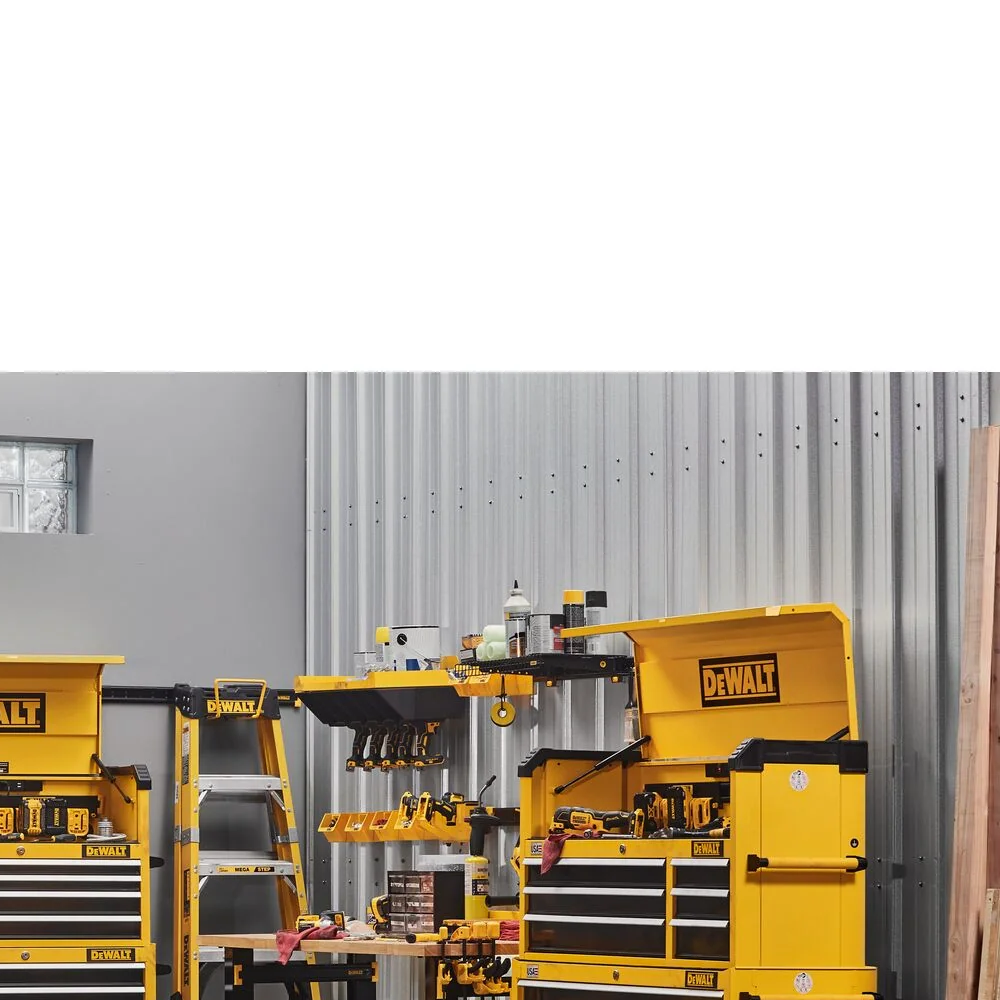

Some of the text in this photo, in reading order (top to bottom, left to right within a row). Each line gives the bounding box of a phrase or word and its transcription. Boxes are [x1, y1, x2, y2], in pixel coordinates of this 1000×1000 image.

[703, 664, 775, 697] DEWALT
[87, 846, 126, 856] DEWALT
[694, 844, 720, 853] DEWALT
[91, 951, 131, 959] DEWALT
[688, 973, 714, 985] DEWALT
